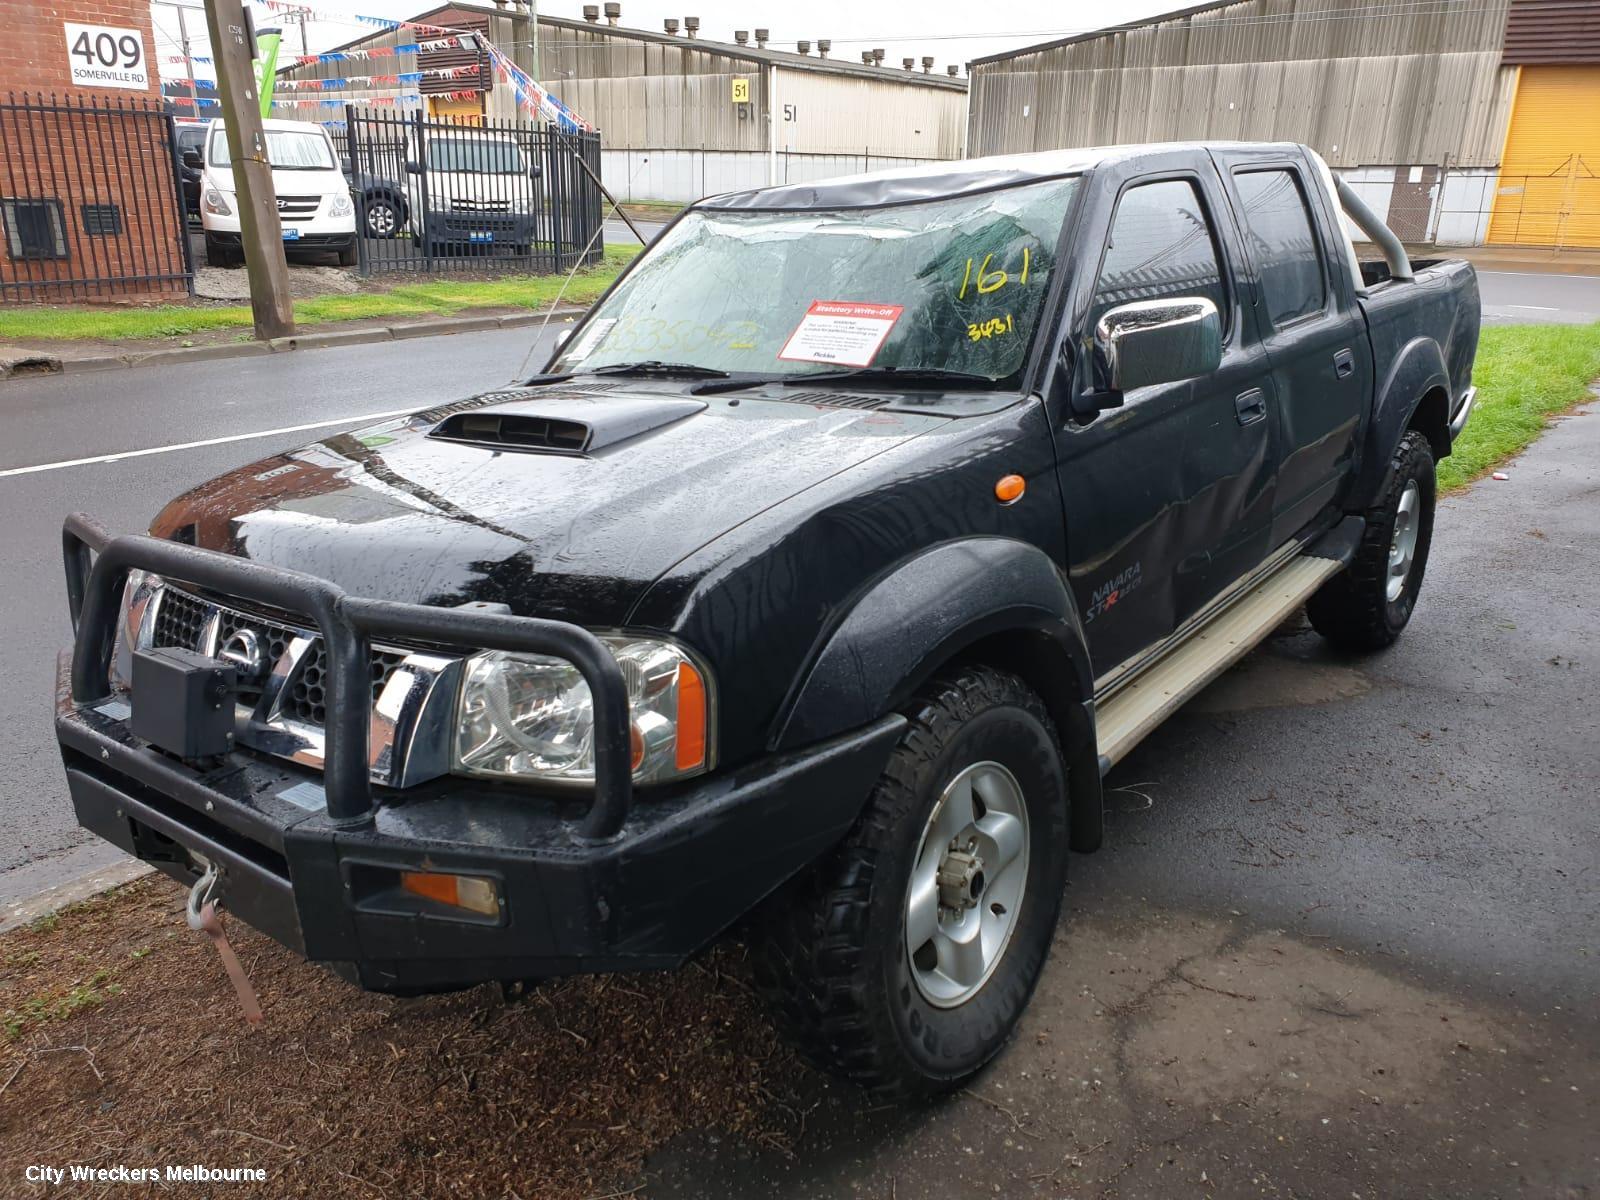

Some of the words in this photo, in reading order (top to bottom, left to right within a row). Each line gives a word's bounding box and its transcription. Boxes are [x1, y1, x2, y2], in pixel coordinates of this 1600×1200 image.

[71, 31, 141, 69] 409
[73, 68, 130, 82] SOMERVILLE
[131, 73, 146, 83] RD.
[734, 83, 746, 98] 51
[737, 102, 755, 122] 51
[784, 103, 797, 122] 51
[959, 247, 1029, 300] 161
[815, 305, 852, 315] Statutory
[853, 308, 894, 316] Write-Off
[967, 314, 1013, 342] 3431
[1090, 560, 1141, 606] NAVARA
